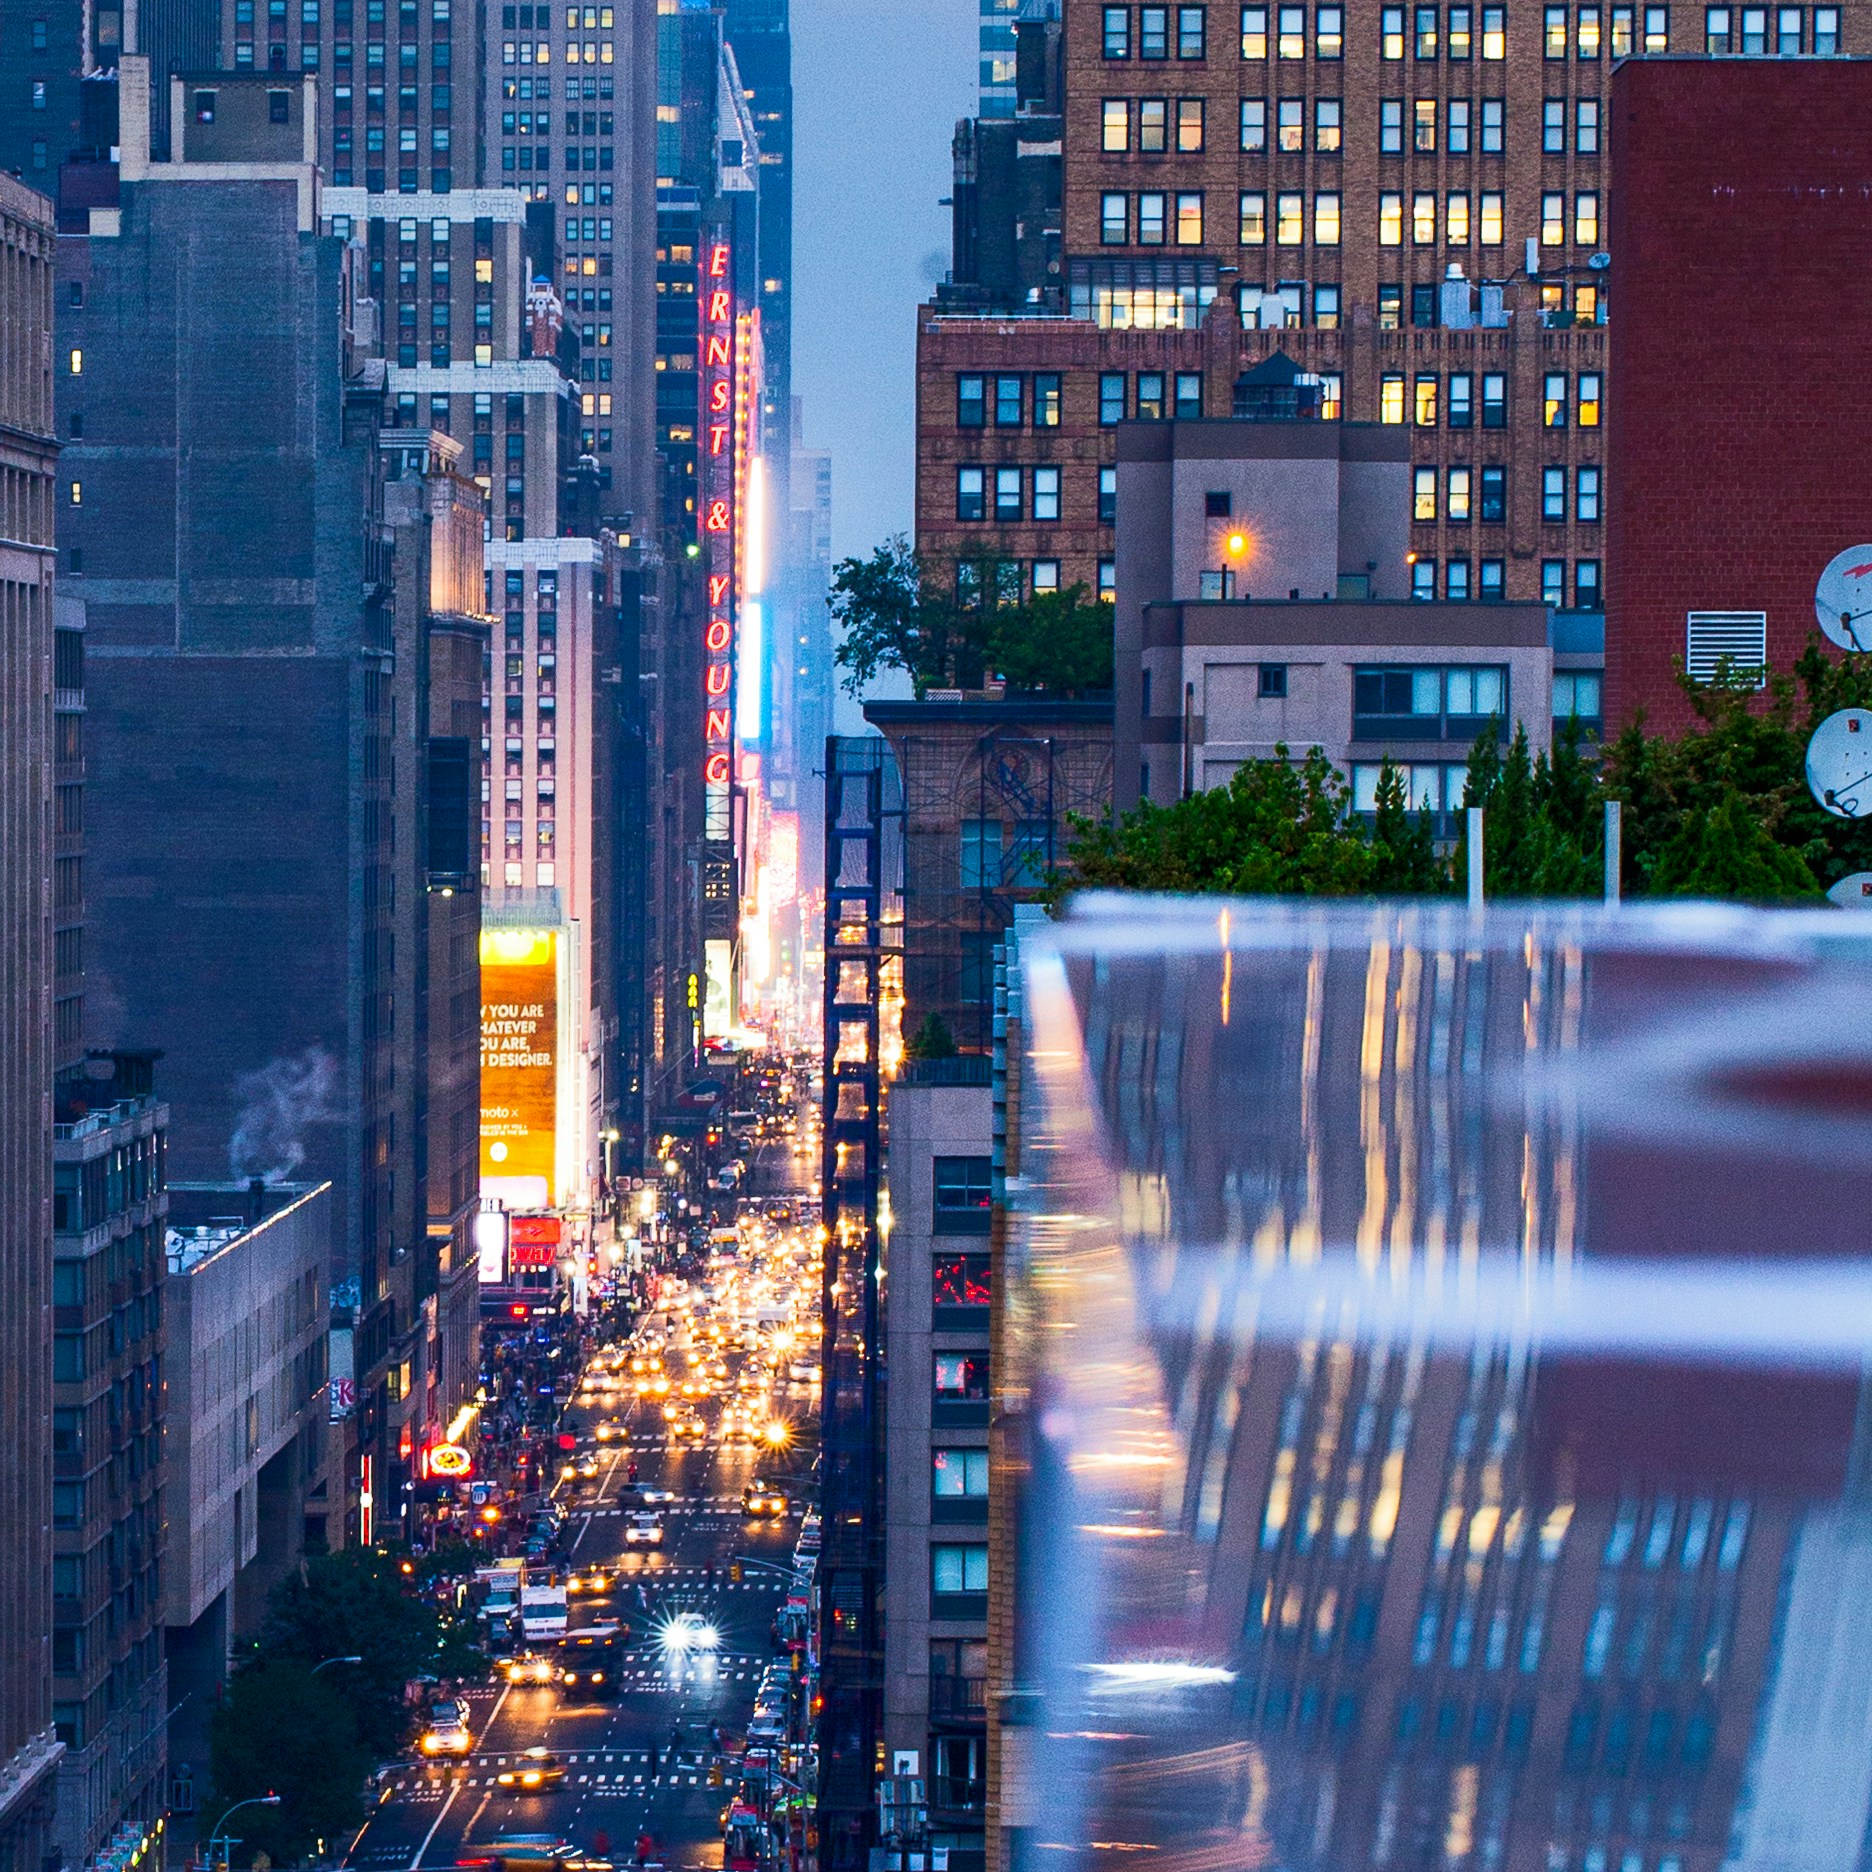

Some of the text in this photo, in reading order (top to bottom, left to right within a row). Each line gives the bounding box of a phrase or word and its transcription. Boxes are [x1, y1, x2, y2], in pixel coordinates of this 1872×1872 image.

[706, 245, 730, 783] ERNST & YOUNG
[489, 1004, 544, 1018] YOU ARE
[500, 1037, 530, 1053] ARE,
[488, 1053, 552, 1067] DESIGNER.
